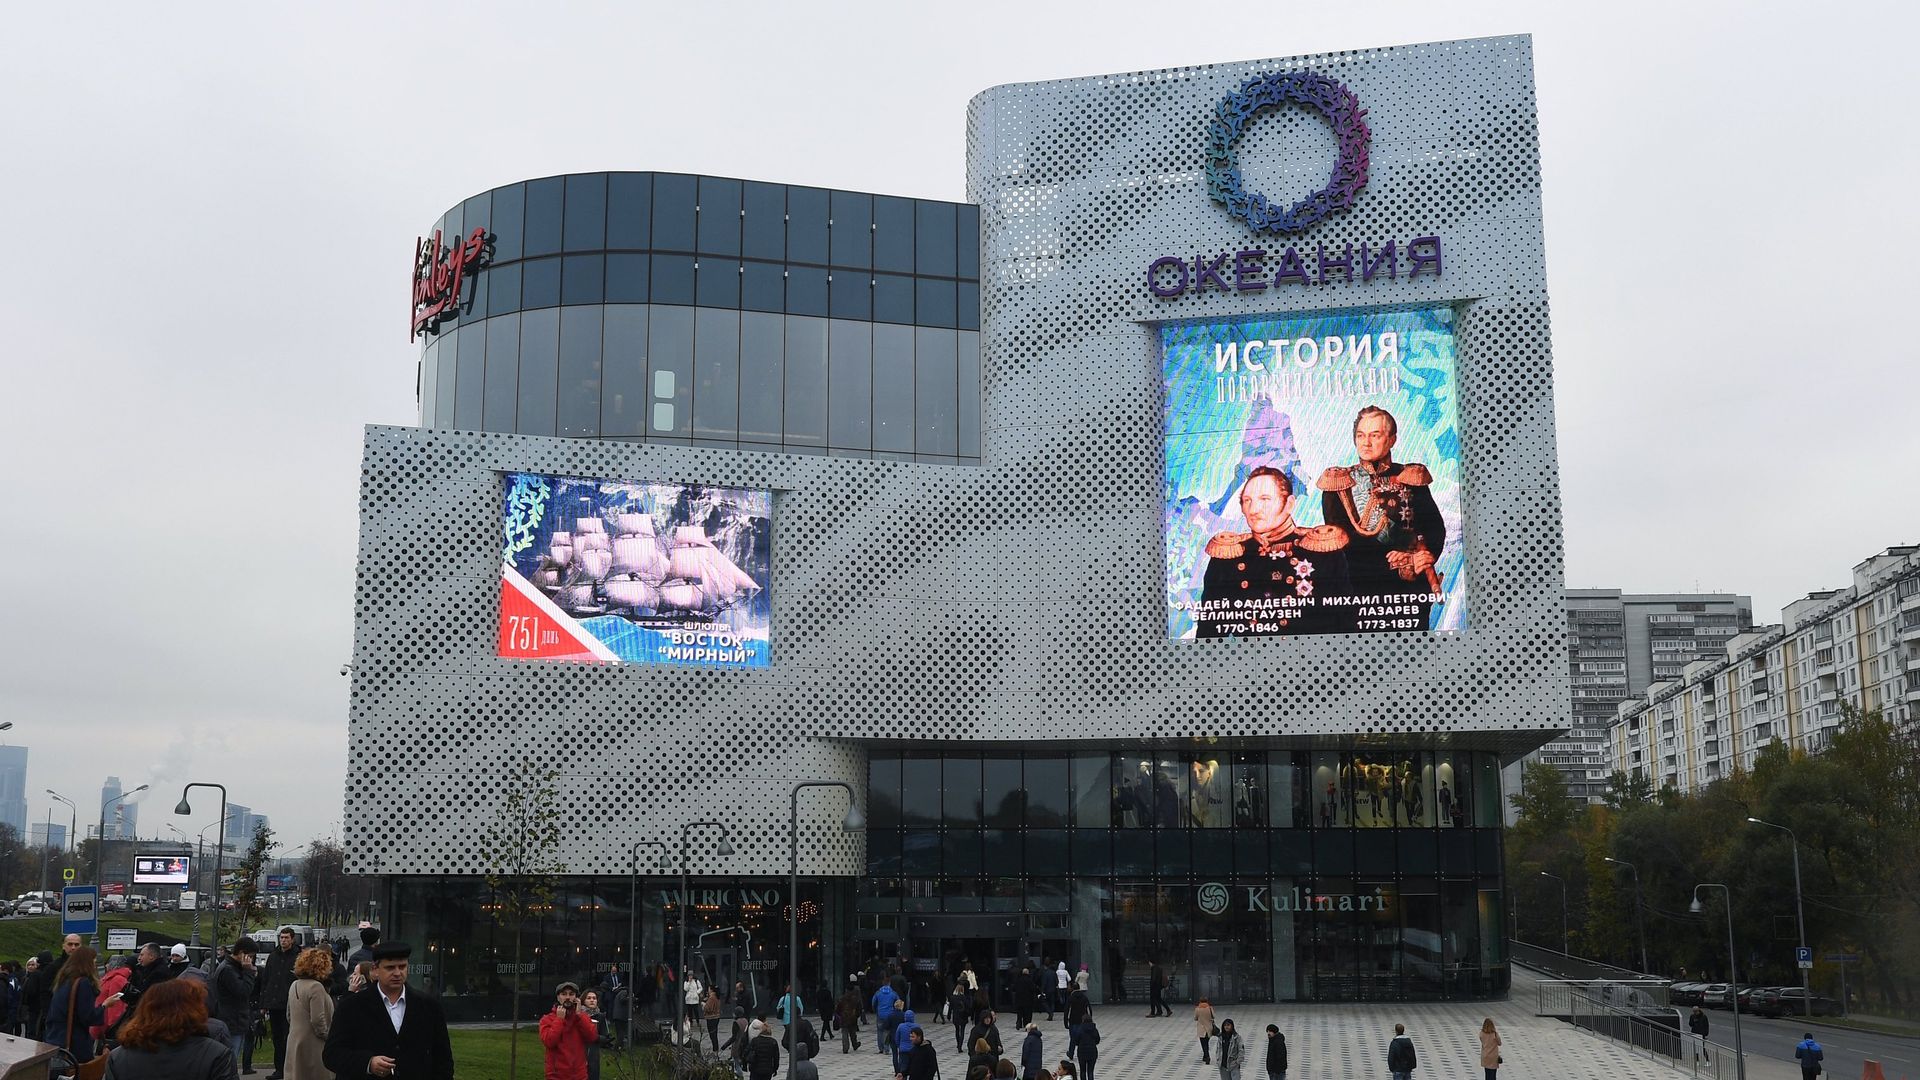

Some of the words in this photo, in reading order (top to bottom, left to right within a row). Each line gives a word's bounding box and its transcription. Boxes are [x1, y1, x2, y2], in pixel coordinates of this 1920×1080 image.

[1147, 236, 1442, 297] ОКЕАНИЯ
[1215, 332, 1398, 373] ИСТОРИЯ
[1175, 599, 1231, 611] ФАДДЕЙ
[1233, 597, 1315, 609] ФАДДЕЕВИЧ
[1322, 594, 1380, 606] МИХАИЛ
[1192, 609, 1302, 621] БЕЛЛИНСГАУЗЕН
[1358, 605, 1420, 616] ЛАЗАРЕВ
[1215, 623, 1279, 633] 1770-1846
[1357, 619, 1420, 629] 1773-1837
[508, 615, 539, 650] 751
[1247, 886, 1385, 912] Kulinari
[1800, 950, 1807, 960] P
[416, 964, 432, 975] STOP
[519, 963, 535, 973] STOP
[763, 960, 778, 970] STOP
